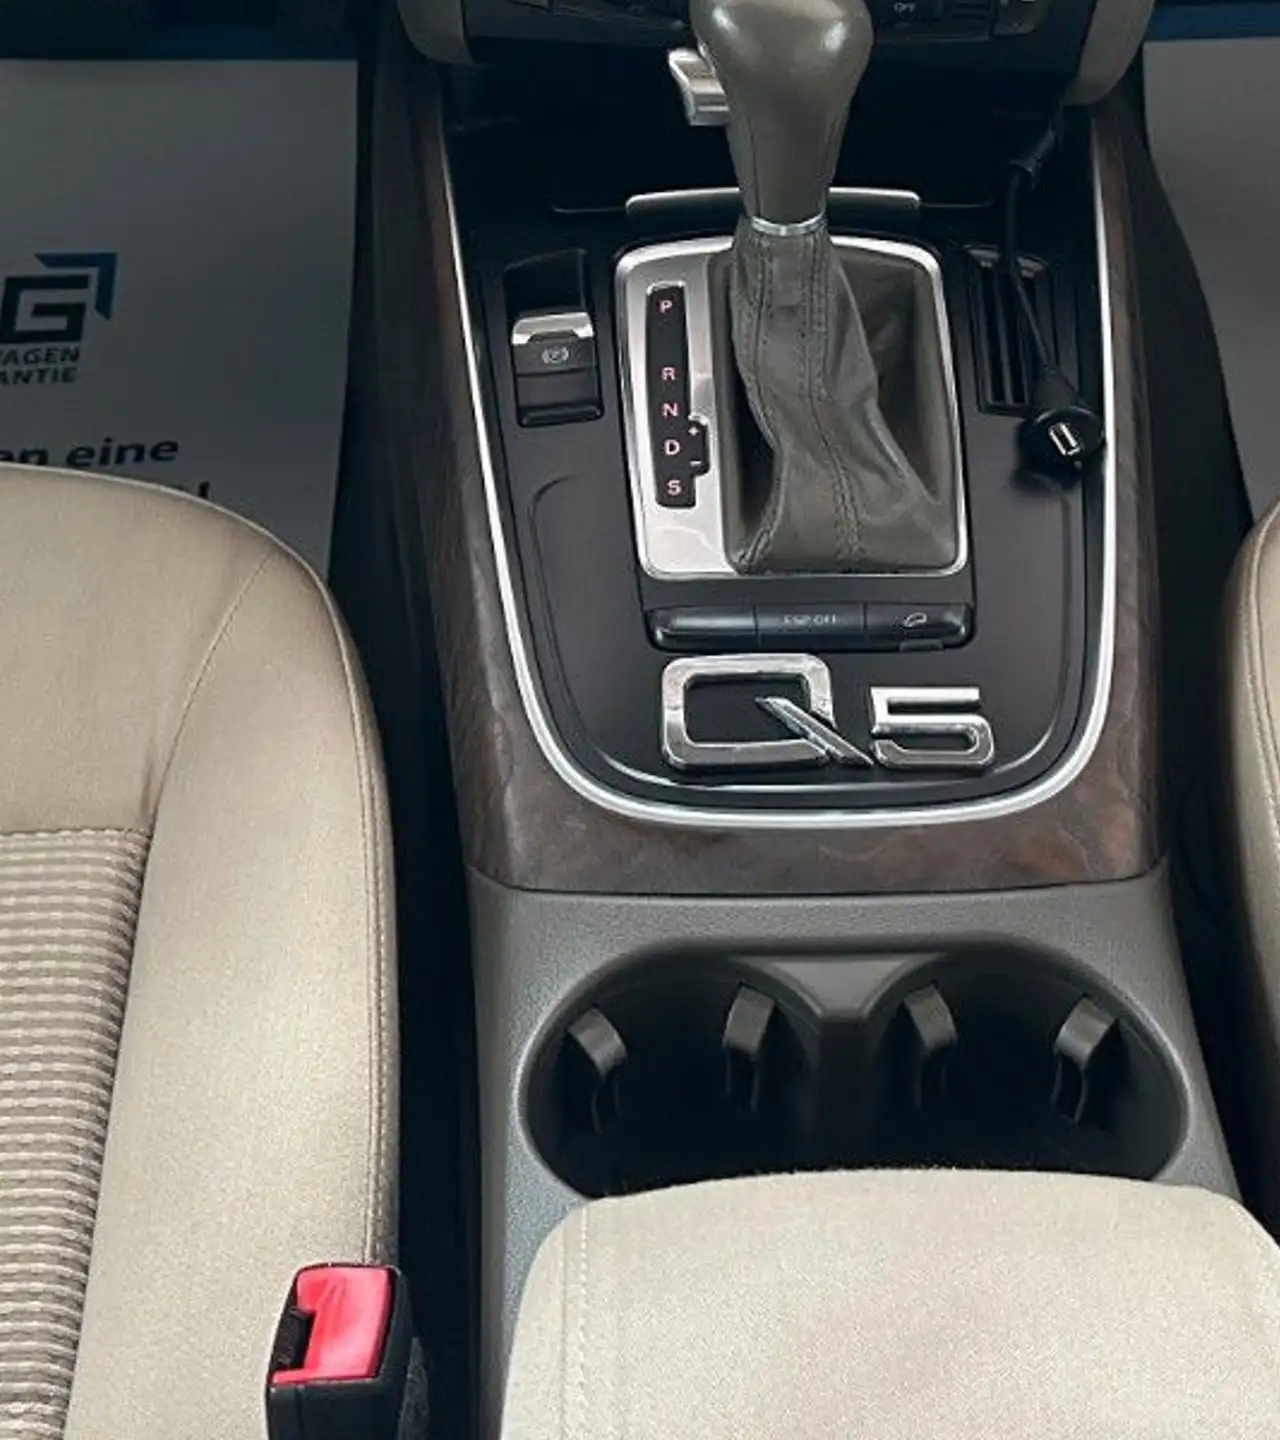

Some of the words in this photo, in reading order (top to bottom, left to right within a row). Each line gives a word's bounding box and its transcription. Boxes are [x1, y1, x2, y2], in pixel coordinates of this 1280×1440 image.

[659, 300, 673, 313] P
[661, 367, 676, 381] R
[662, 403, 678, 418] N
[65, 437, 179, 468] eine
[663, 439, 680, 456] D
[666, 479, 681, 496] S
[661, 654, 995, 769] Q5
